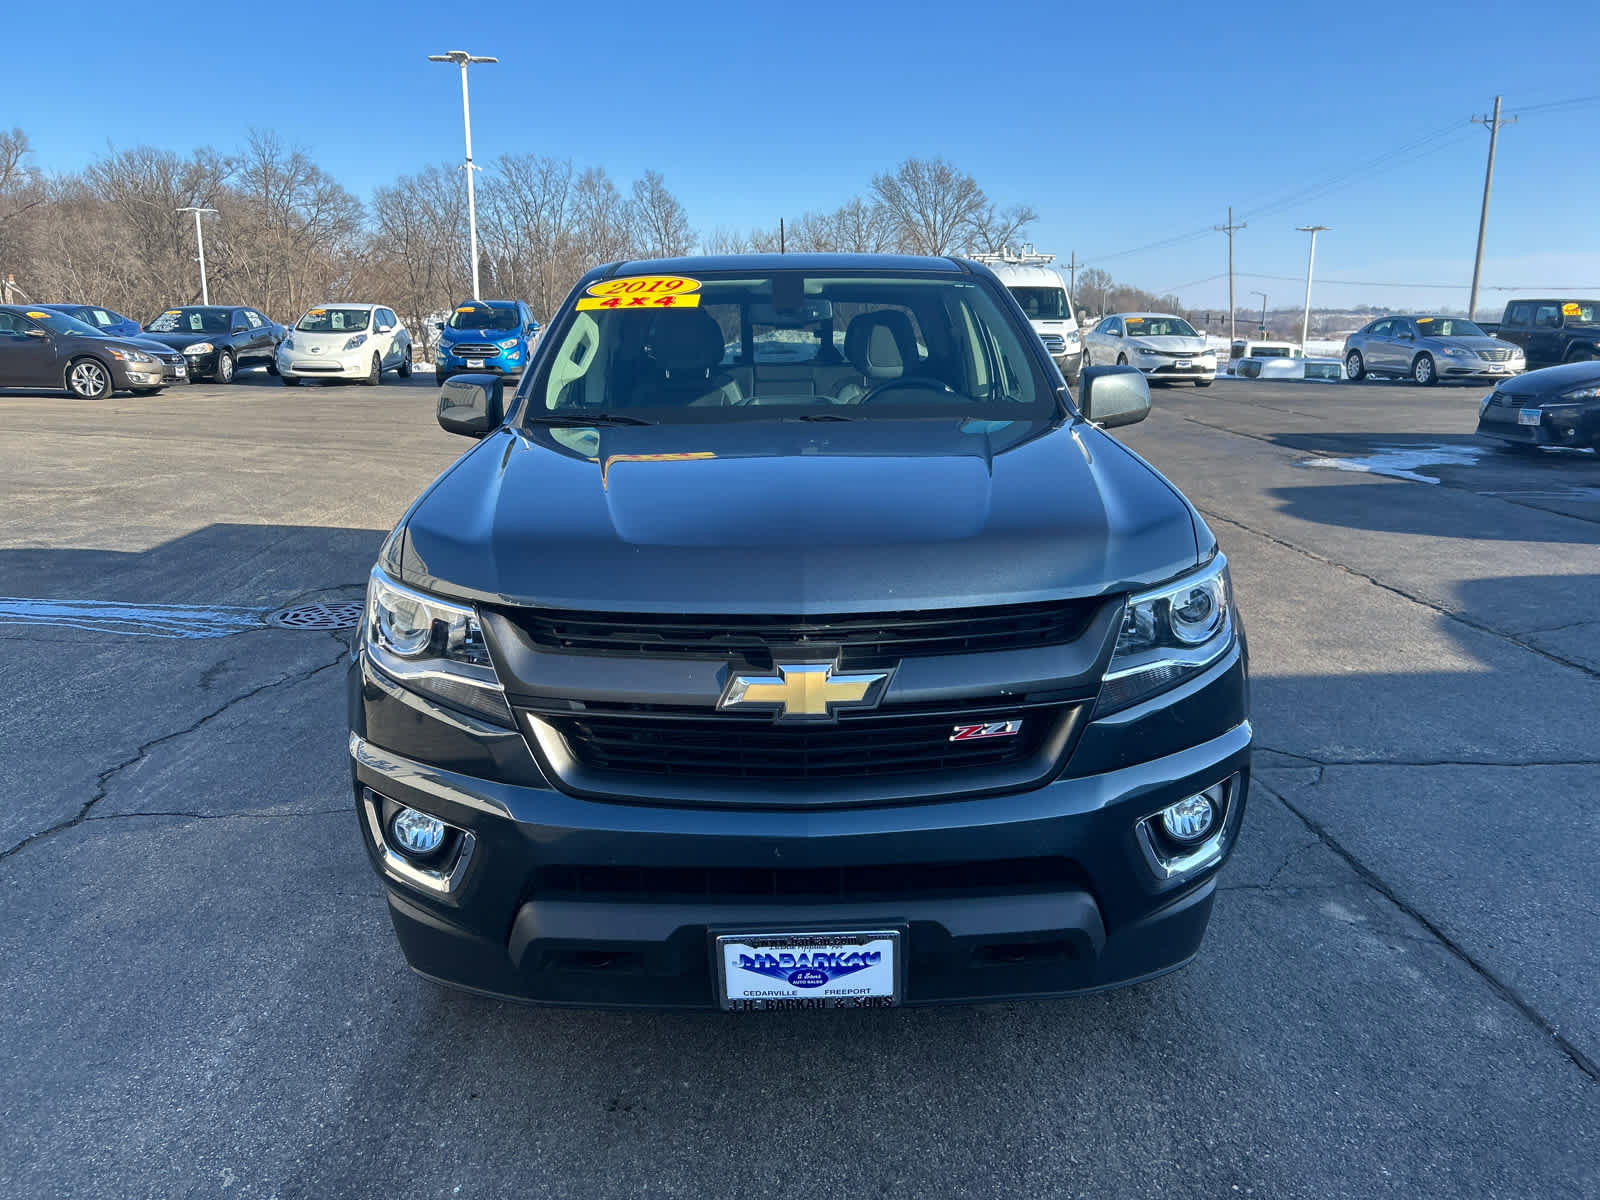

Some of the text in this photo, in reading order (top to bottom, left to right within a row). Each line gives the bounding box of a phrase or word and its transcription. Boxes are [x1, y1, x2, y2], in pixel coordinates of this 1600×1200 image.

[604, 280, 684, 295] 2019
[743, 987, 872, 997] CEDARVILLE FREEPORT
[766, 998, 826, 1010] BARKAU
[836, 998, 845, 1008] &
[853, 996, 893, 1008] SONS
